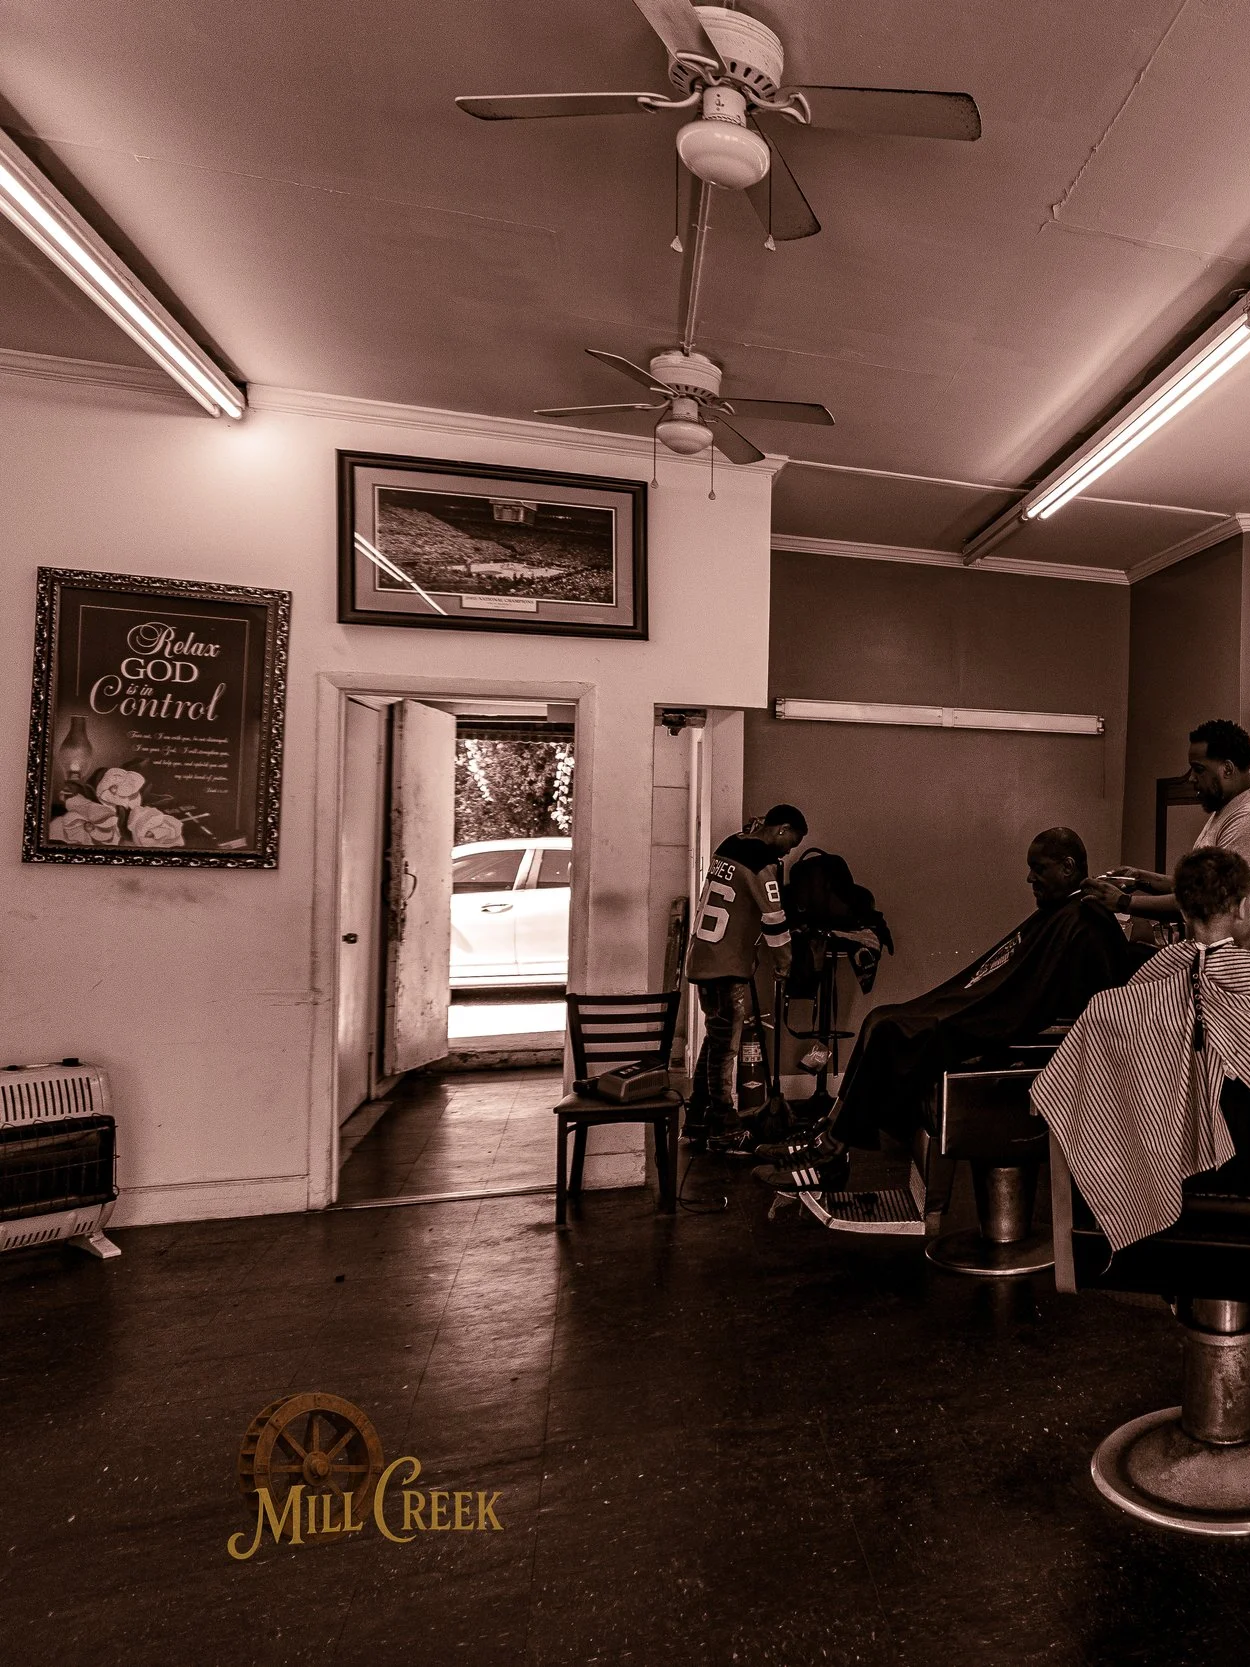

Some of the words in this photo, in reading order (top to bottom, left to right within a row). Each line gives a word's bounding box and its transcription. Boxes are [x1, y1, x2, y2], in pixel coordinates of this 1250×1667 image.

[127, 622, 221, 659] Relax
[121, 658, 199, 683] GOD
[90, 674, 227, 721] Control
[126, 683, 138, 696] is
[139, 684, 155, 697] in
[764, 880, 780, 902] 8
[696, 880, 736, 943] 6
